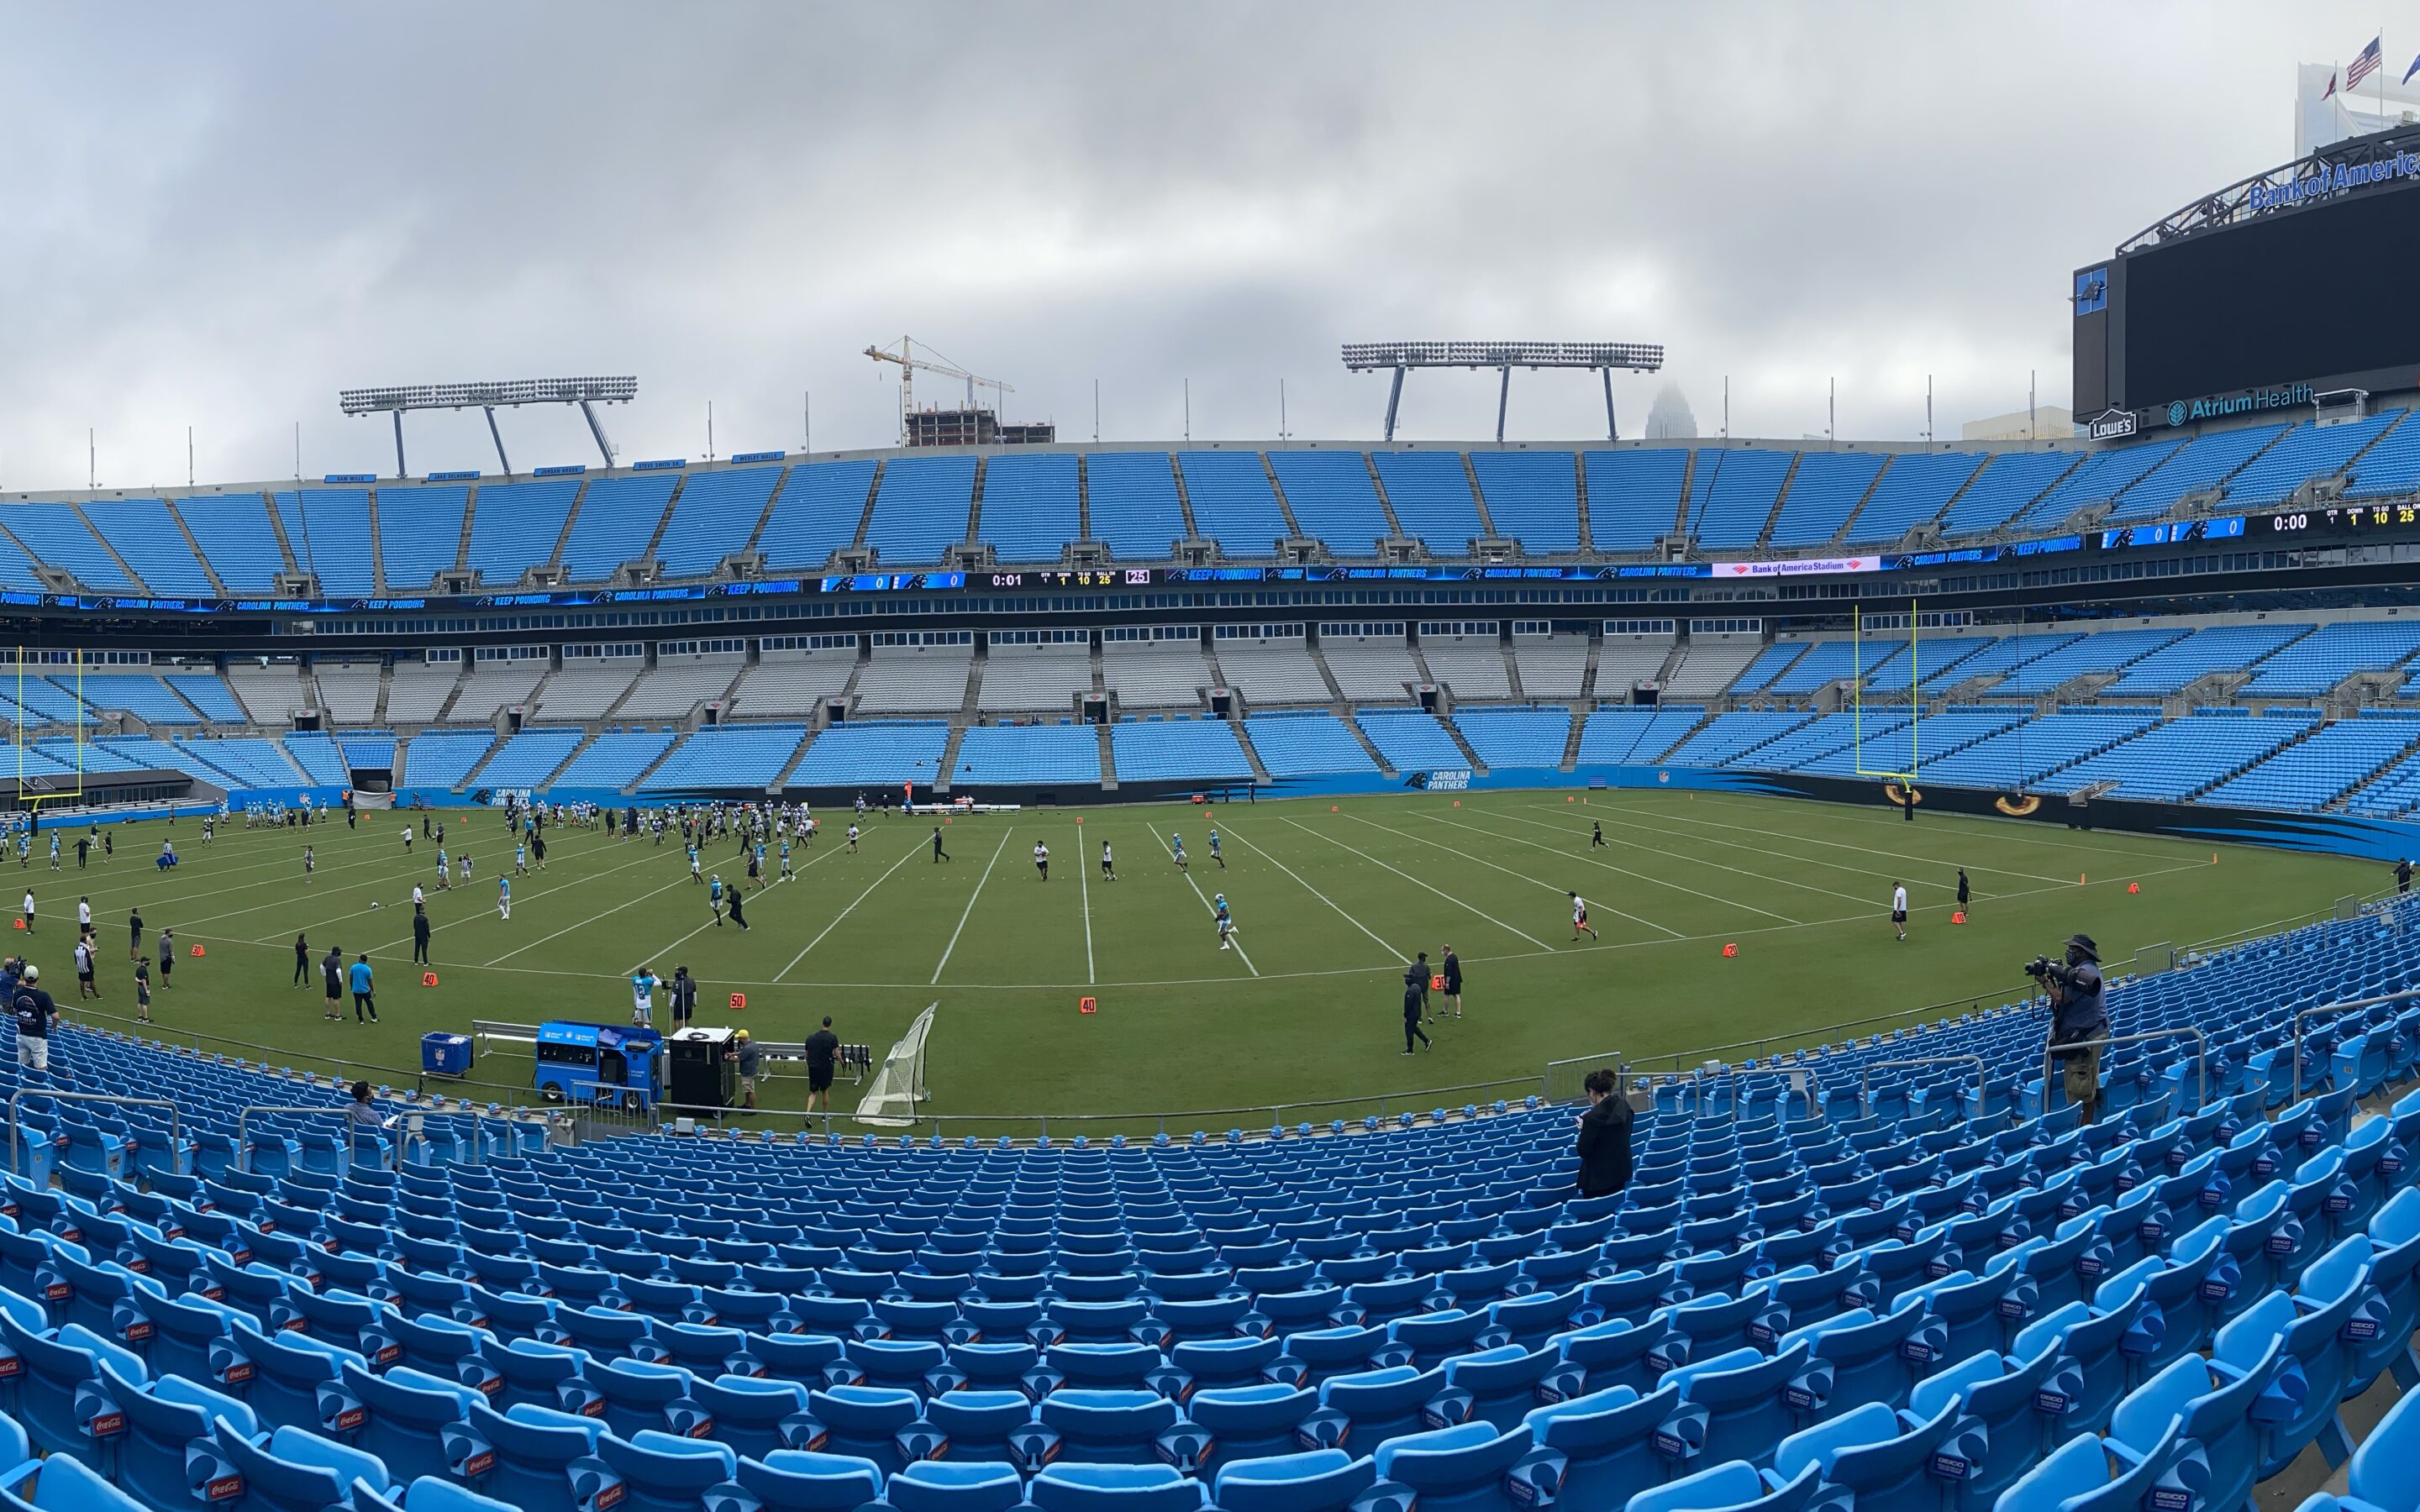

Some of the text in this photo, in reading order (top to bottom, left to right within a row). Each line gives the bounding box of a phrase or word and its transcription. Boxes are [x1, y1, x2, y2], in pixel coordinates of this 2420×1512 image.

[2249, 150, 2420, 210] Bank of Americ
[2191, 383, 2314, 419] Atrium Health
[2093, 418, 2132, 438] LOWE'S
[2274, 514, 2307, 531] 0:00
[2351, 514, 2356, 525] 1
[2374, 512, 2387, 523] 10
[2400, 510, 2414, 522] 25
[2018, 536, 2081, 555] KEEP POUNDING
[1914, 550, 1982, 565] CAROLINA PANTHERS
[1619, 566, 1697, 576] CAROLINA PANTHERS
[1752, 561, 1844, 573] Bank of America Stadium
[1189, 569, 1260, 580] KEEP POUNDING
[1349, 569, 1427, 578] CAROLINA PANTHERS
[1485, 569, 1562, 578] CAROLINA PANTHERS
[992, 575, 1021, 586] 0:01
[1099, 576, 1111, 585] 25
[728, 580, 799, 596] KEEP POUNDING
[1, 592, 39, 605] POUNDING
[494, 594, 550, 606] KEEP POUNDING
[614, 588, 688, 601] CAROLINA PANTHERS
[116, 599, 185, 610] CAROLINA PANTHERS
[237, 601, 309, 610] CAROLINA PANTHERS
[369, 600, 425, 609] KEEP POUNDING
[1432, 771, 1470, 780] CAROLINA
[1428, 780, 1469, 790] PANTHERS
[496, 789, 531, 798] CAROLINA
[1957, 912, 1965, 922] 10
[192, 946, 202, 955] 30
[1728, 945, 1738, 957] 20
[424, 974, 434, 985] 40
[732, 995, 743, 1007] 50
[1083, 998, 1096, 1011] 40
[1907, 1345, 1928, 1353] GEICO
[1788, 1390, 1810, 1400] GEICO
[2039, 1394, 2063, 1403] GEICO
[97, 1418, 121, 1430] Coca-Cola
[1658, 1436, 1680, 1446] GEICO
[1938, 1457, 1965, 1468] GEICO
[212, 1481, 239, 1494] Coca-Cola
[2155, 1492, 2187, 1501] GEICO
